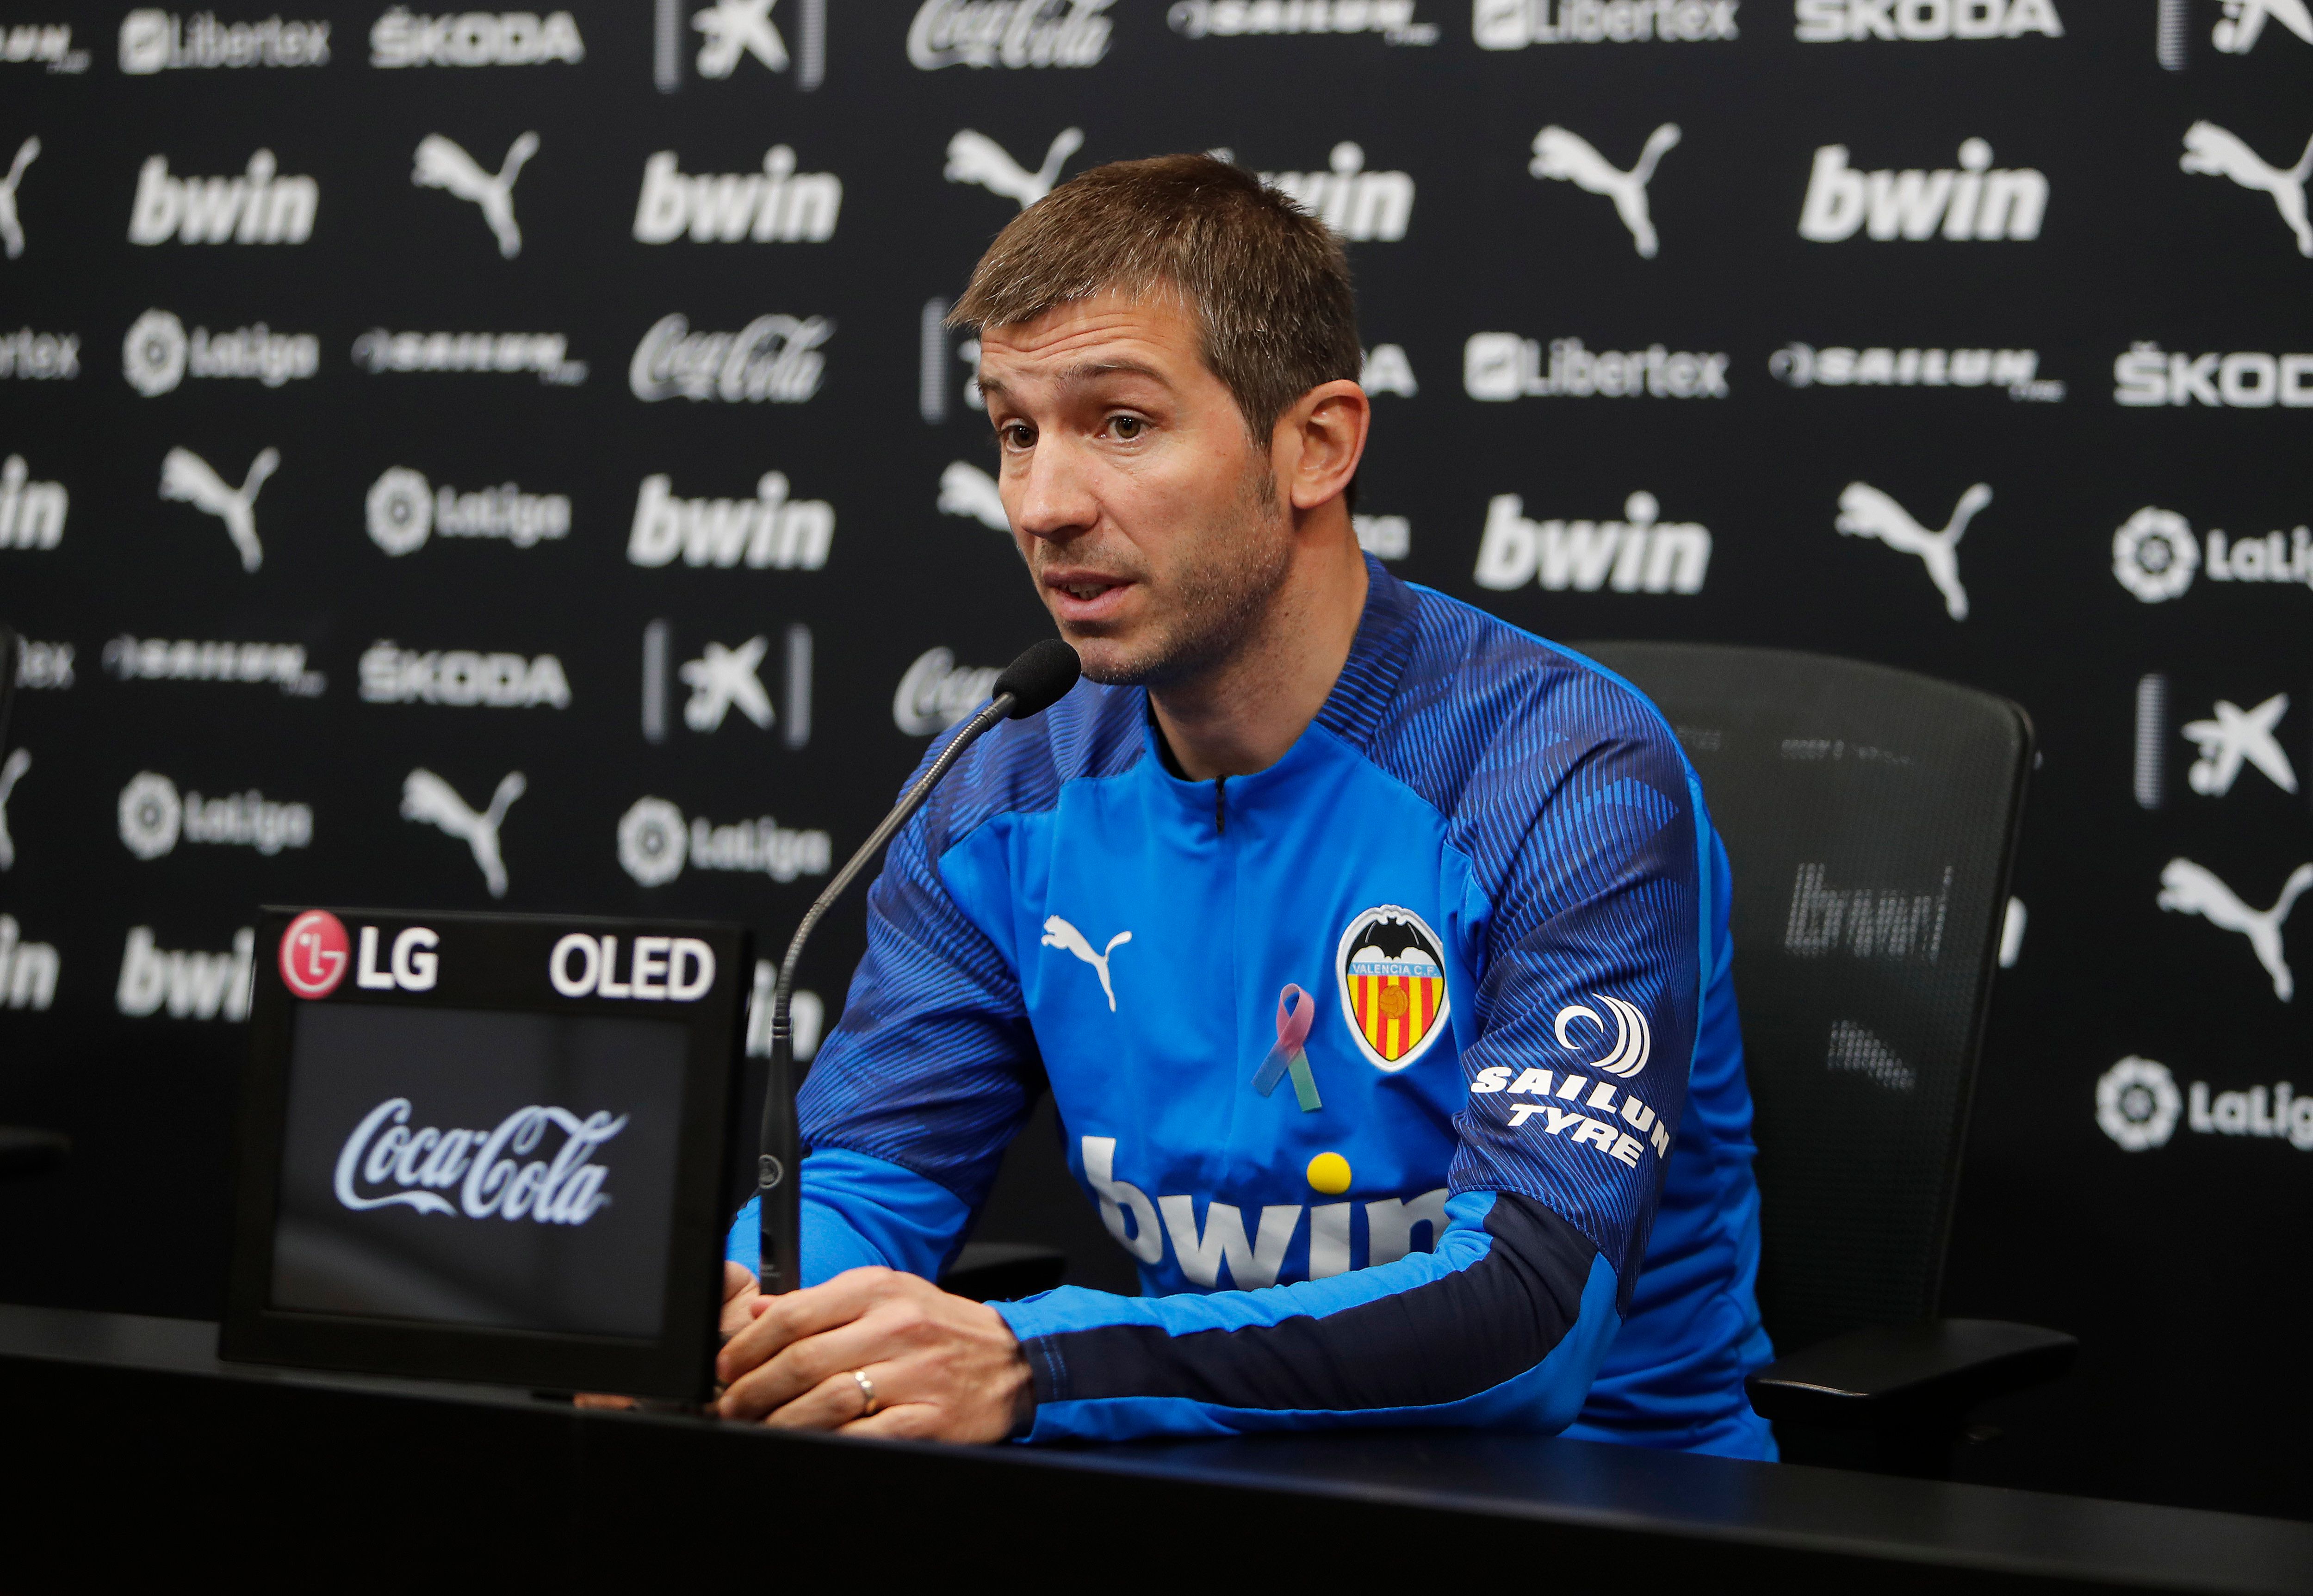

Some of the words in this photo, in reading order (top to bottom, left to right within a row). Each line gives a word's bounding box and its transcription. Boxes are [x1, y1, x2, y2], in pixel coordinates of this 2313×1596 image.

[128, 147, 320, 246] bwin
[632, 143, 843, 245] bwin
[1205, 141, 1416, 242] win
[1798, 137, 2051, 243] bwin
[1520, 337, 1730, 399] Libertex
[626, 470, 837, 570] bwin
[1473, 490, 1713, 595] bwin
[358, 637, 572, 709] ŠKODA
[357, 926, 440, 991] LG
[549, 933, 716, 1002] OLED
[1352, 964, 1411, 975] VALENCIA
[1413, 965, 1437, 977] C.F.
[334, 1097, 630, 1225] Coca-Cola
[1470, 1066, 1670, 1159] SAILUN
[1507, 1103, 1645, 1169] TYRE
[1081, 1135, 1450, 1291] bwin
